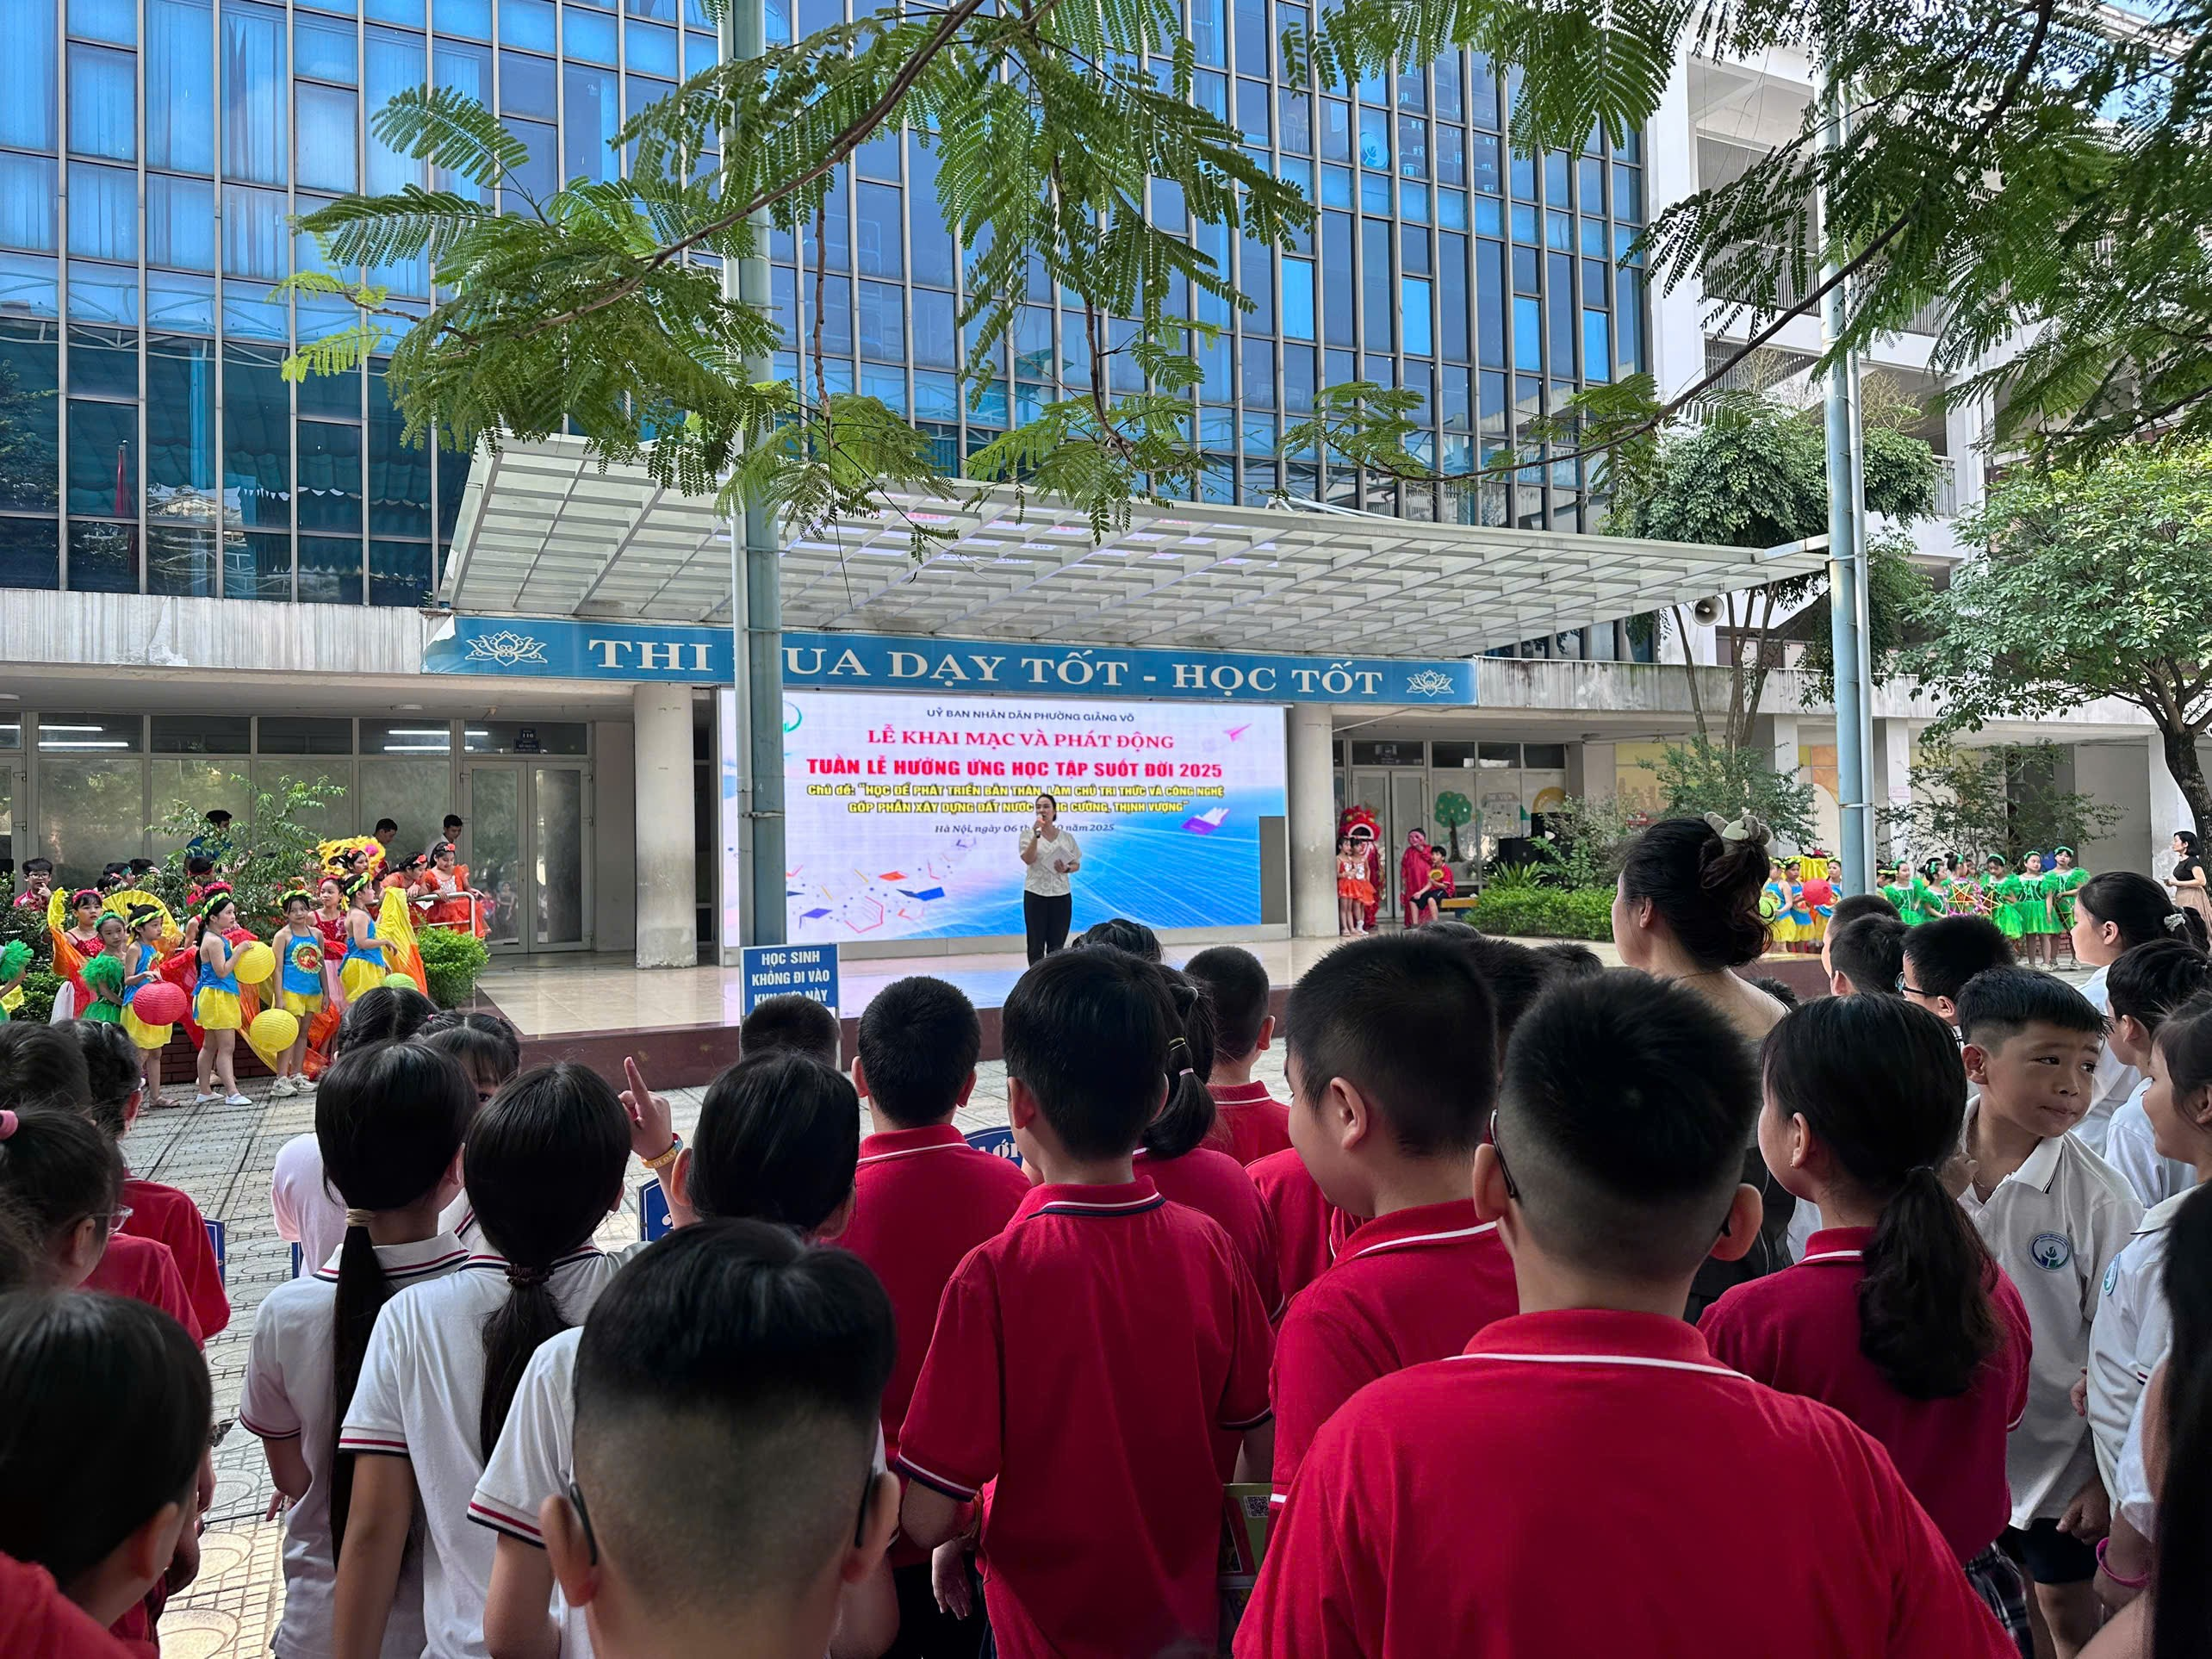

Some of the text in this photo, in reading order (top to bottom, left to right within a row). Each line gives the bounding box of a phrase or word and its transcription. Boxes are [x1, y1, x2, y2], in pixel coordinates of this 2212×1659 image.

[588, 639, 713, 671] THI
[733, 648, 872, 677] UA
[886, 651, 1007, 687] DẠY
[1021, 649, 1128, 687] TỐT
[1172, 664, 1277, 696] HỌC
[1291, 660, 1383, 695] TỐT
[927, 706, 1135, 722] UỶ BAN NHÂN DÂN PHƯỜNG GIẢNG VÕ
[867, 724, 1175, 753] LỄ KHAI MẠC VÀ PHÁT ĐỘNG
[806, 754, 1222, 780] TUẦN LỄ HƯỞNG ỨNG HỌC TẬP SUỐT ĐỜI 2025
[807, 782, 833, 796] Chủ
[912, 783, 944, 796] PHÁT
[948, 782, 981, 796] TRIỂN
[984, 783, 1009, 796] BẢN
[1047, 784, 1072, 796] LÀM
[1074, 783, 1097, 796] CHỦ
[1099, 786, 1117, 797] TRI
[1119, 785, 1146, 797] THỨC
[1148, 785, 1164, 796] VÀ
[1165, 785, 1195, 797] CÔNG
[1196, 785, 1225, 798] NGHỆ
[848, 800, 875, 813] GÓP
[877, 799, 912, 813] PHẦN
[914, 801, 939, 813] XÂY
[941, 802, 975, 815] DỰNG
[977, 799, 1000, 812] ĐẤT
[1003, 800, 1034, 812] NƯỚC
[1071, 800, 1111, 813] CƯỜNG,
[1114, 802, 1146, 815] THỊNH
[935, 824, 950, 833] Hà
[974, 824, 1001, 834] ngày
[1003, 824, 1018, 833] 06
[1066, 823, 1088, 832] năm
[1089, 823, 1115, 832] 2025
[761, 951, 820, 966] HỌC SINH
[751, 968, 830, 986] KHÔNG ĐI VÀO
[805, 987, 828, 1002] NÀY
